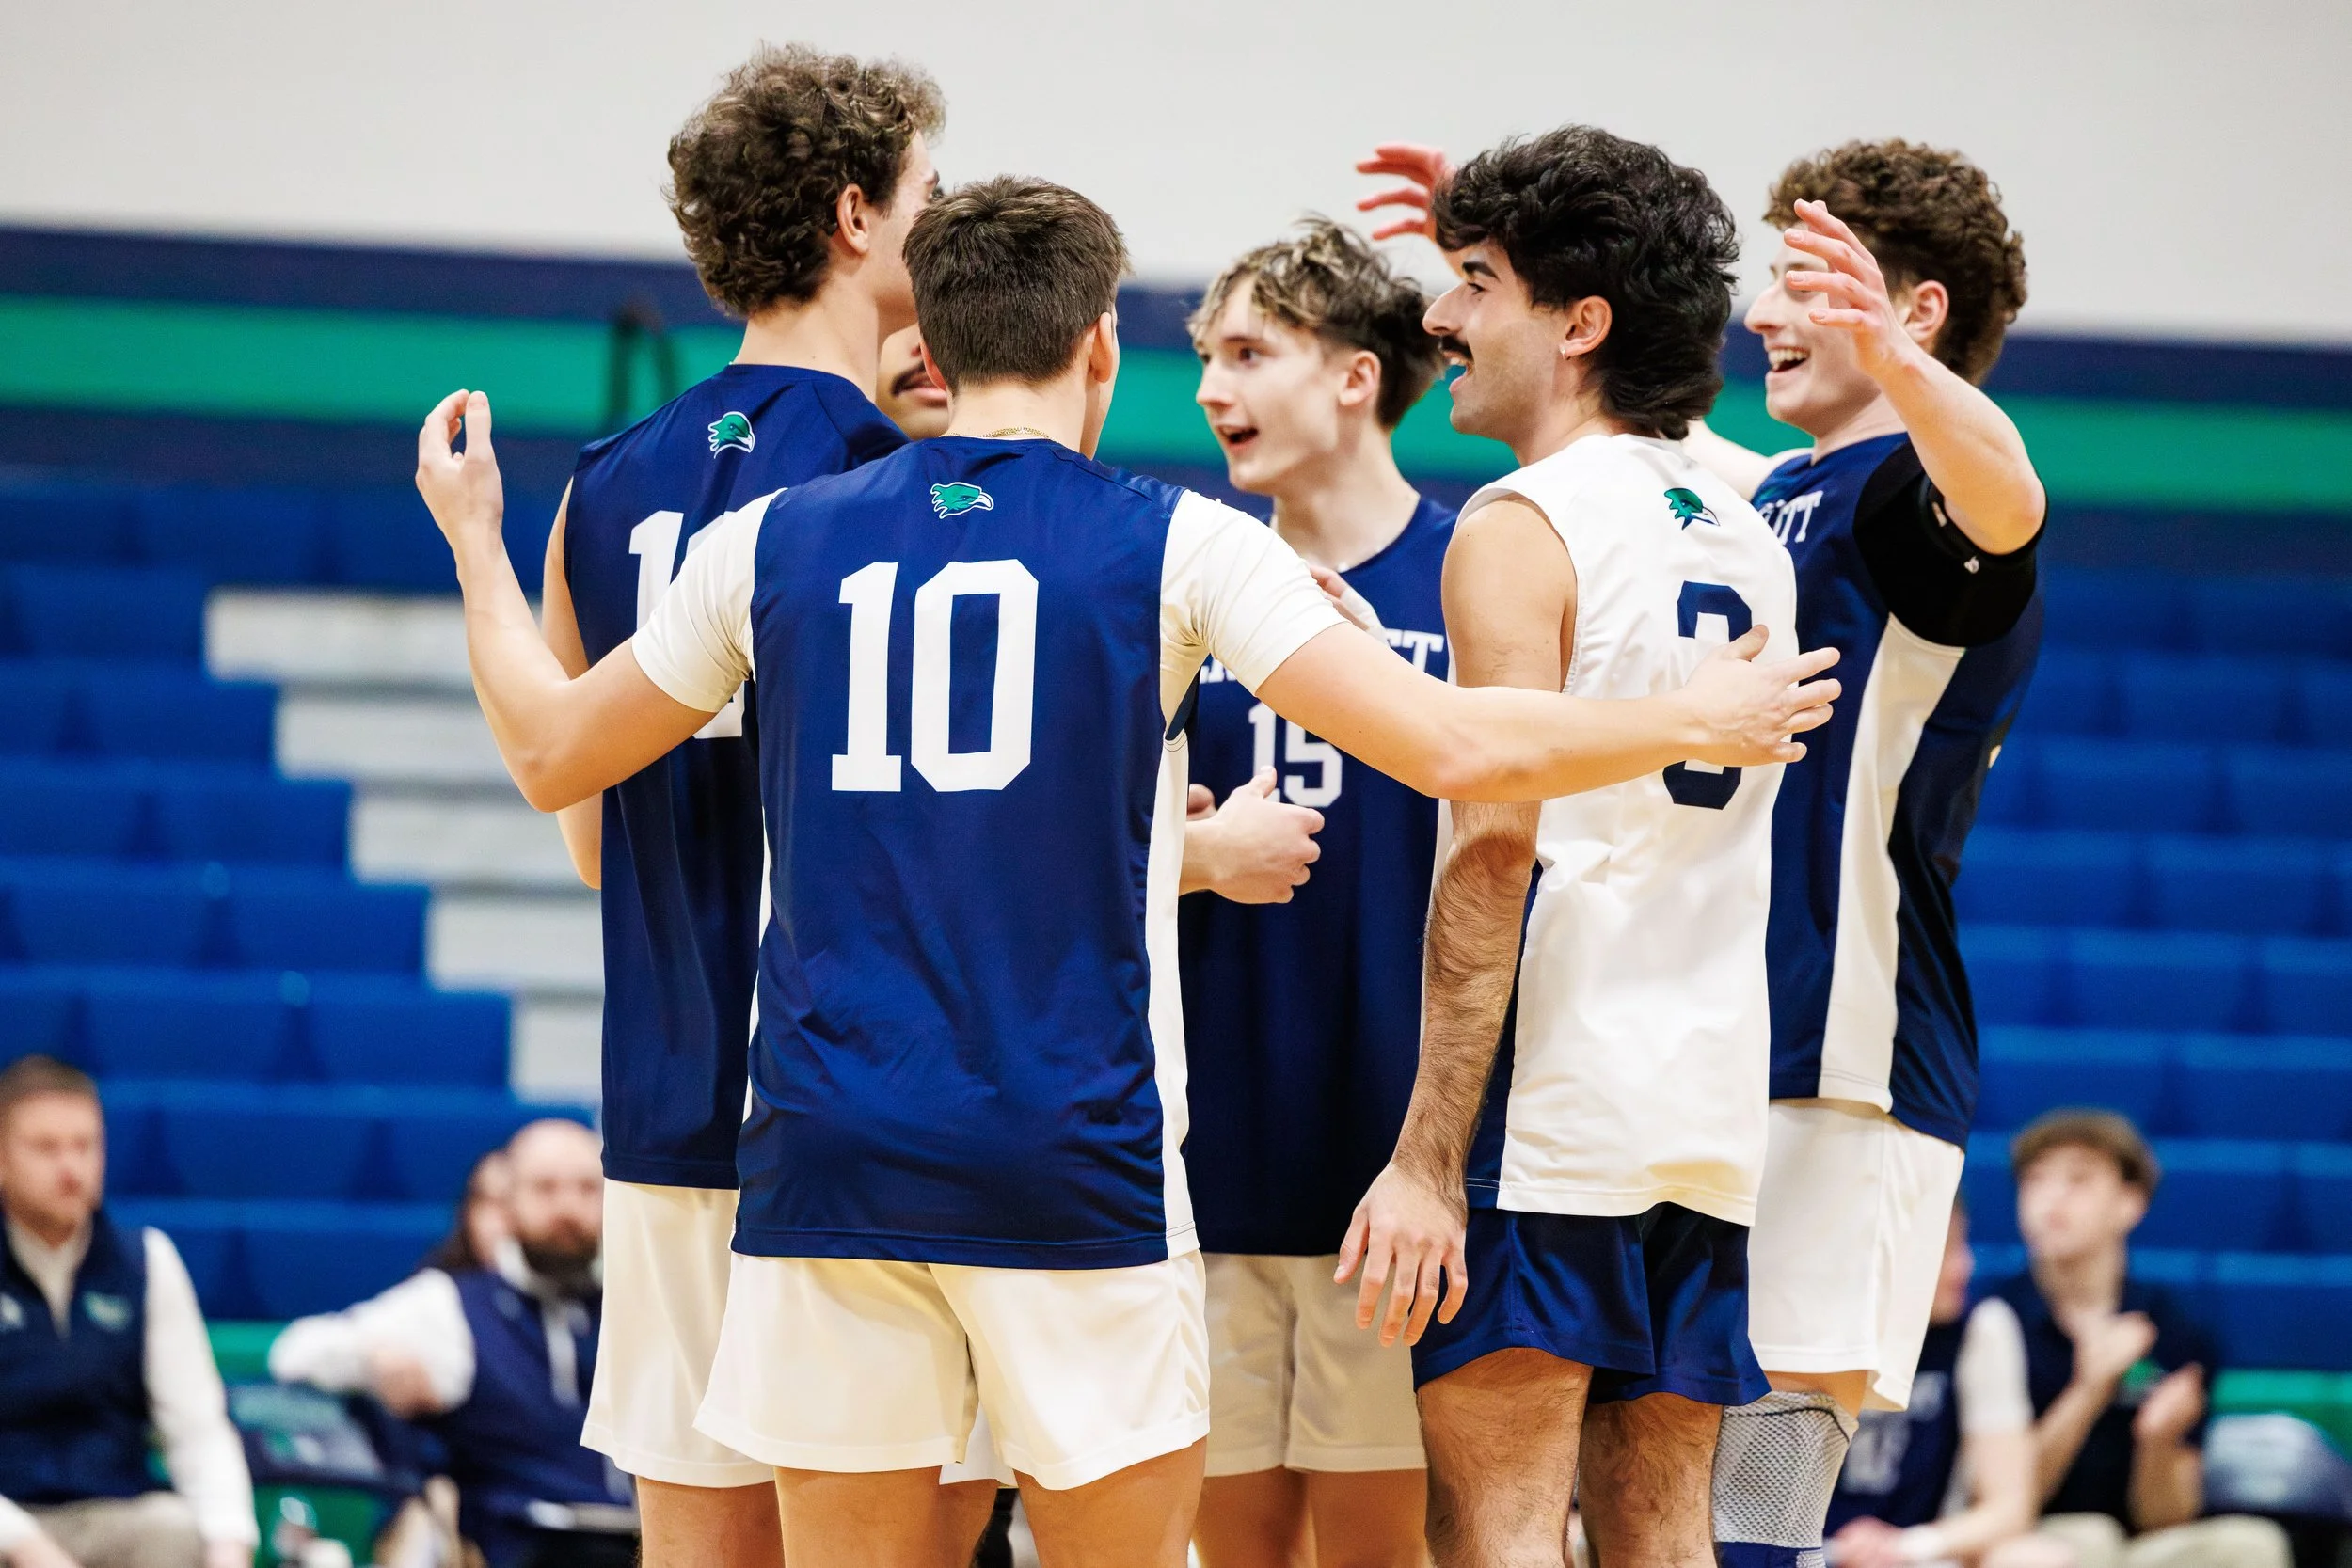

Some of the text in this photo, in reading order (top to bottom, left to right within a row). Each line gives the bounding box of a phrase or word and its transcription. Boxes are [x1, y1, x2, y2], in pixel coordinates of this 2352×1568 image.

[628, 510, 746, 740] 1
[832, 559, 1039, 792] 10
[1248, 702, 1343, 808] 15
